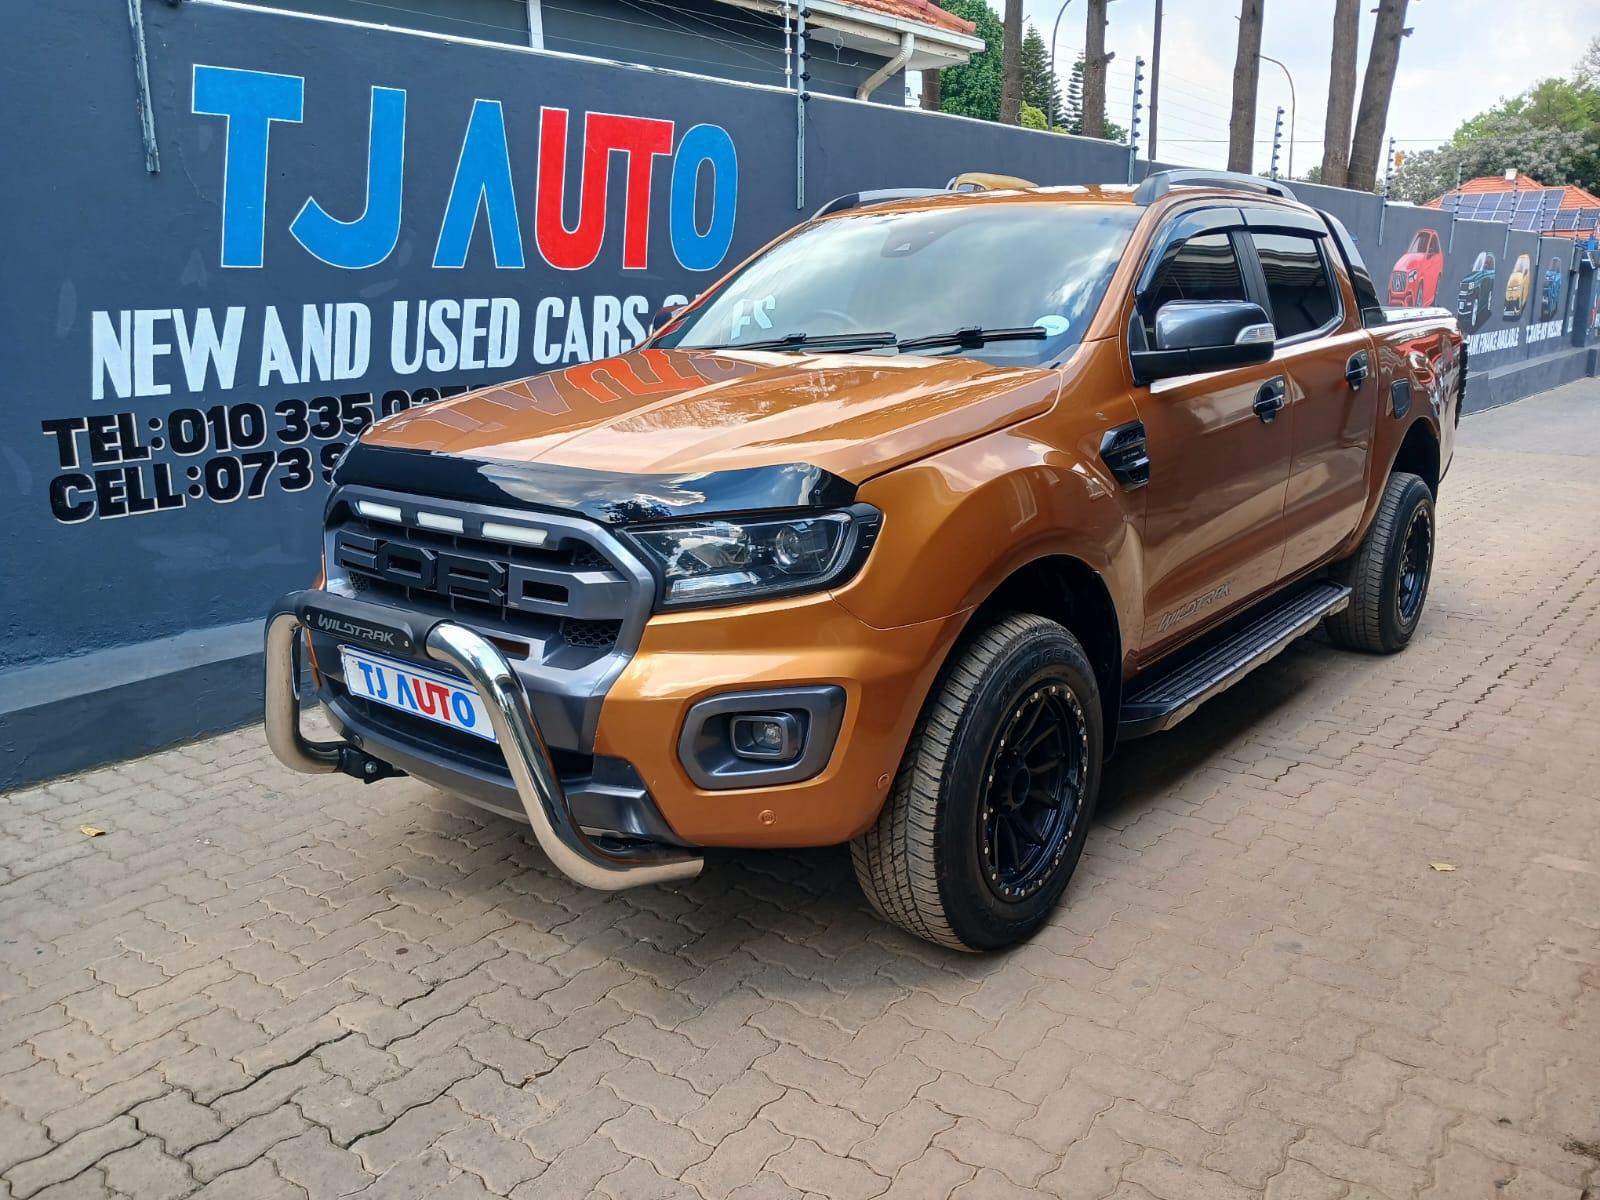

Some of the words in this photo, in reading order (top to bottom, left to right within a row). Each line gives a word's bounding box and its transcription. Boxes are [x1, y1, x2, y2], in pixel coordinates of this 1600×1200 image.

[192, 63, 407, 269] TJ
[432, 98, 738, 270] AUTO
[92, 306, 246, 400] NEW
[258, 302, 370, 386] AND
[391, 297, 520, 375] USED
[533, 295, 649, 365] CARS
[41, 402, 267, 470] TEL:010
[275, 392, 375, 444] 335
[49, 447, 314, 525] CELL:073
[334, 529, 586, 613] FORD
[317, 613, 396, 646] WILDTRAK
[358, 660, 389, 700] TJ
[397, 673, 476, 728] AUTO
